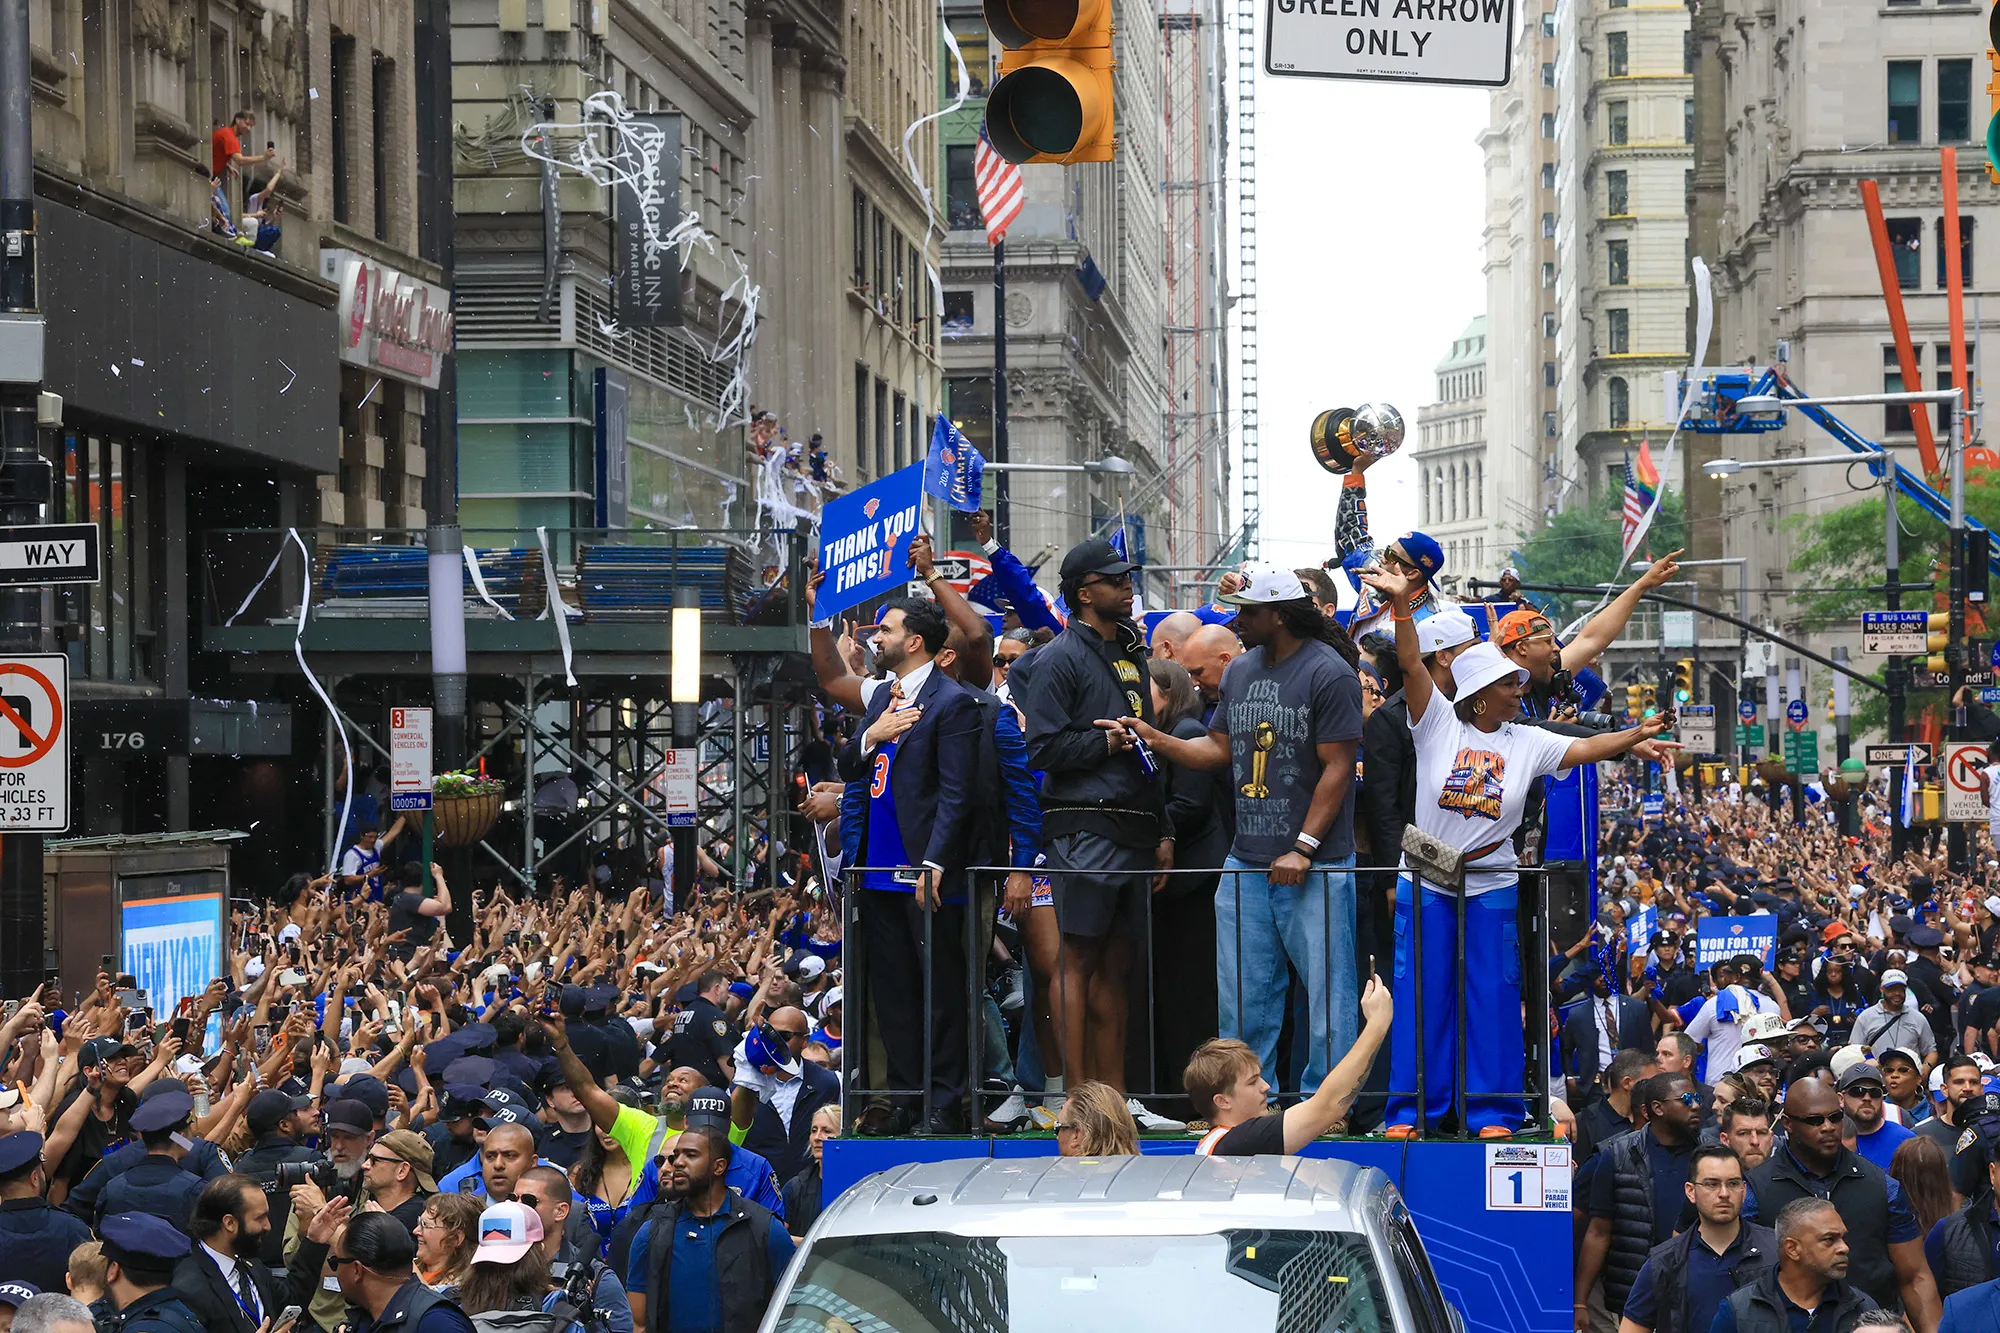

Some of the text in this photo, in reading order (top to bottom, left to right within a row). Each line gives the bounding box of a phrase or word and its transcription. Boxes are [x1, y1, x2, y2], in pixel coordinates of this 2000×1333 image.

[1393, 0, 1503, 23] ARROW
[1345, 27, 1432, 57] ONLY
[629, 223, 641, 306] BY MARRIOTT
[644, 276, 662, 308] INN
[938, 468, 950, 488] 2026
[824, 505, 916, 571] THANK YOU
[24, 543, 75, 566] WAY
[836, 548, 884, 594] FANS!
[942, 566, 961, 574] WAY
[1882, 613, 1922, 621] BUS LANE
[1900, 622, 1922, 630] ONLY
[1571, 679, 1588, 698] NBA
[395, 710, 402, 727] 3
[101, 732, 145, 749] 176
[393, 732, 424, 740] COMMERCIAL
[394, 741, 416, 749] VEHICLES
[1276, 742, 1296, 760] 26
[668, 751, 674, 764] 3
[1875, 751, 1893, 759] ONE
[1453, 747, 1505, 783] KNICKS
[0, 772, 25, 786] FOR
[0, 790, 46, 803] HICLES
[393, 798, 417, 808] 100057
[1438, 790, 1501, 820] CHAMPIONS
[14, 807, 31, 821] 33
[38, 807, 54, 821] FT
[1950, 809, 1970, 817] OVER
[1700, 936, 1773, 950] WON FOR THE
[692, 1098, 725, 1112] NYPD
[1508, 1171, 1522, 1204] 1
[1545, 1201, 1568, 1209] VEHICLE
